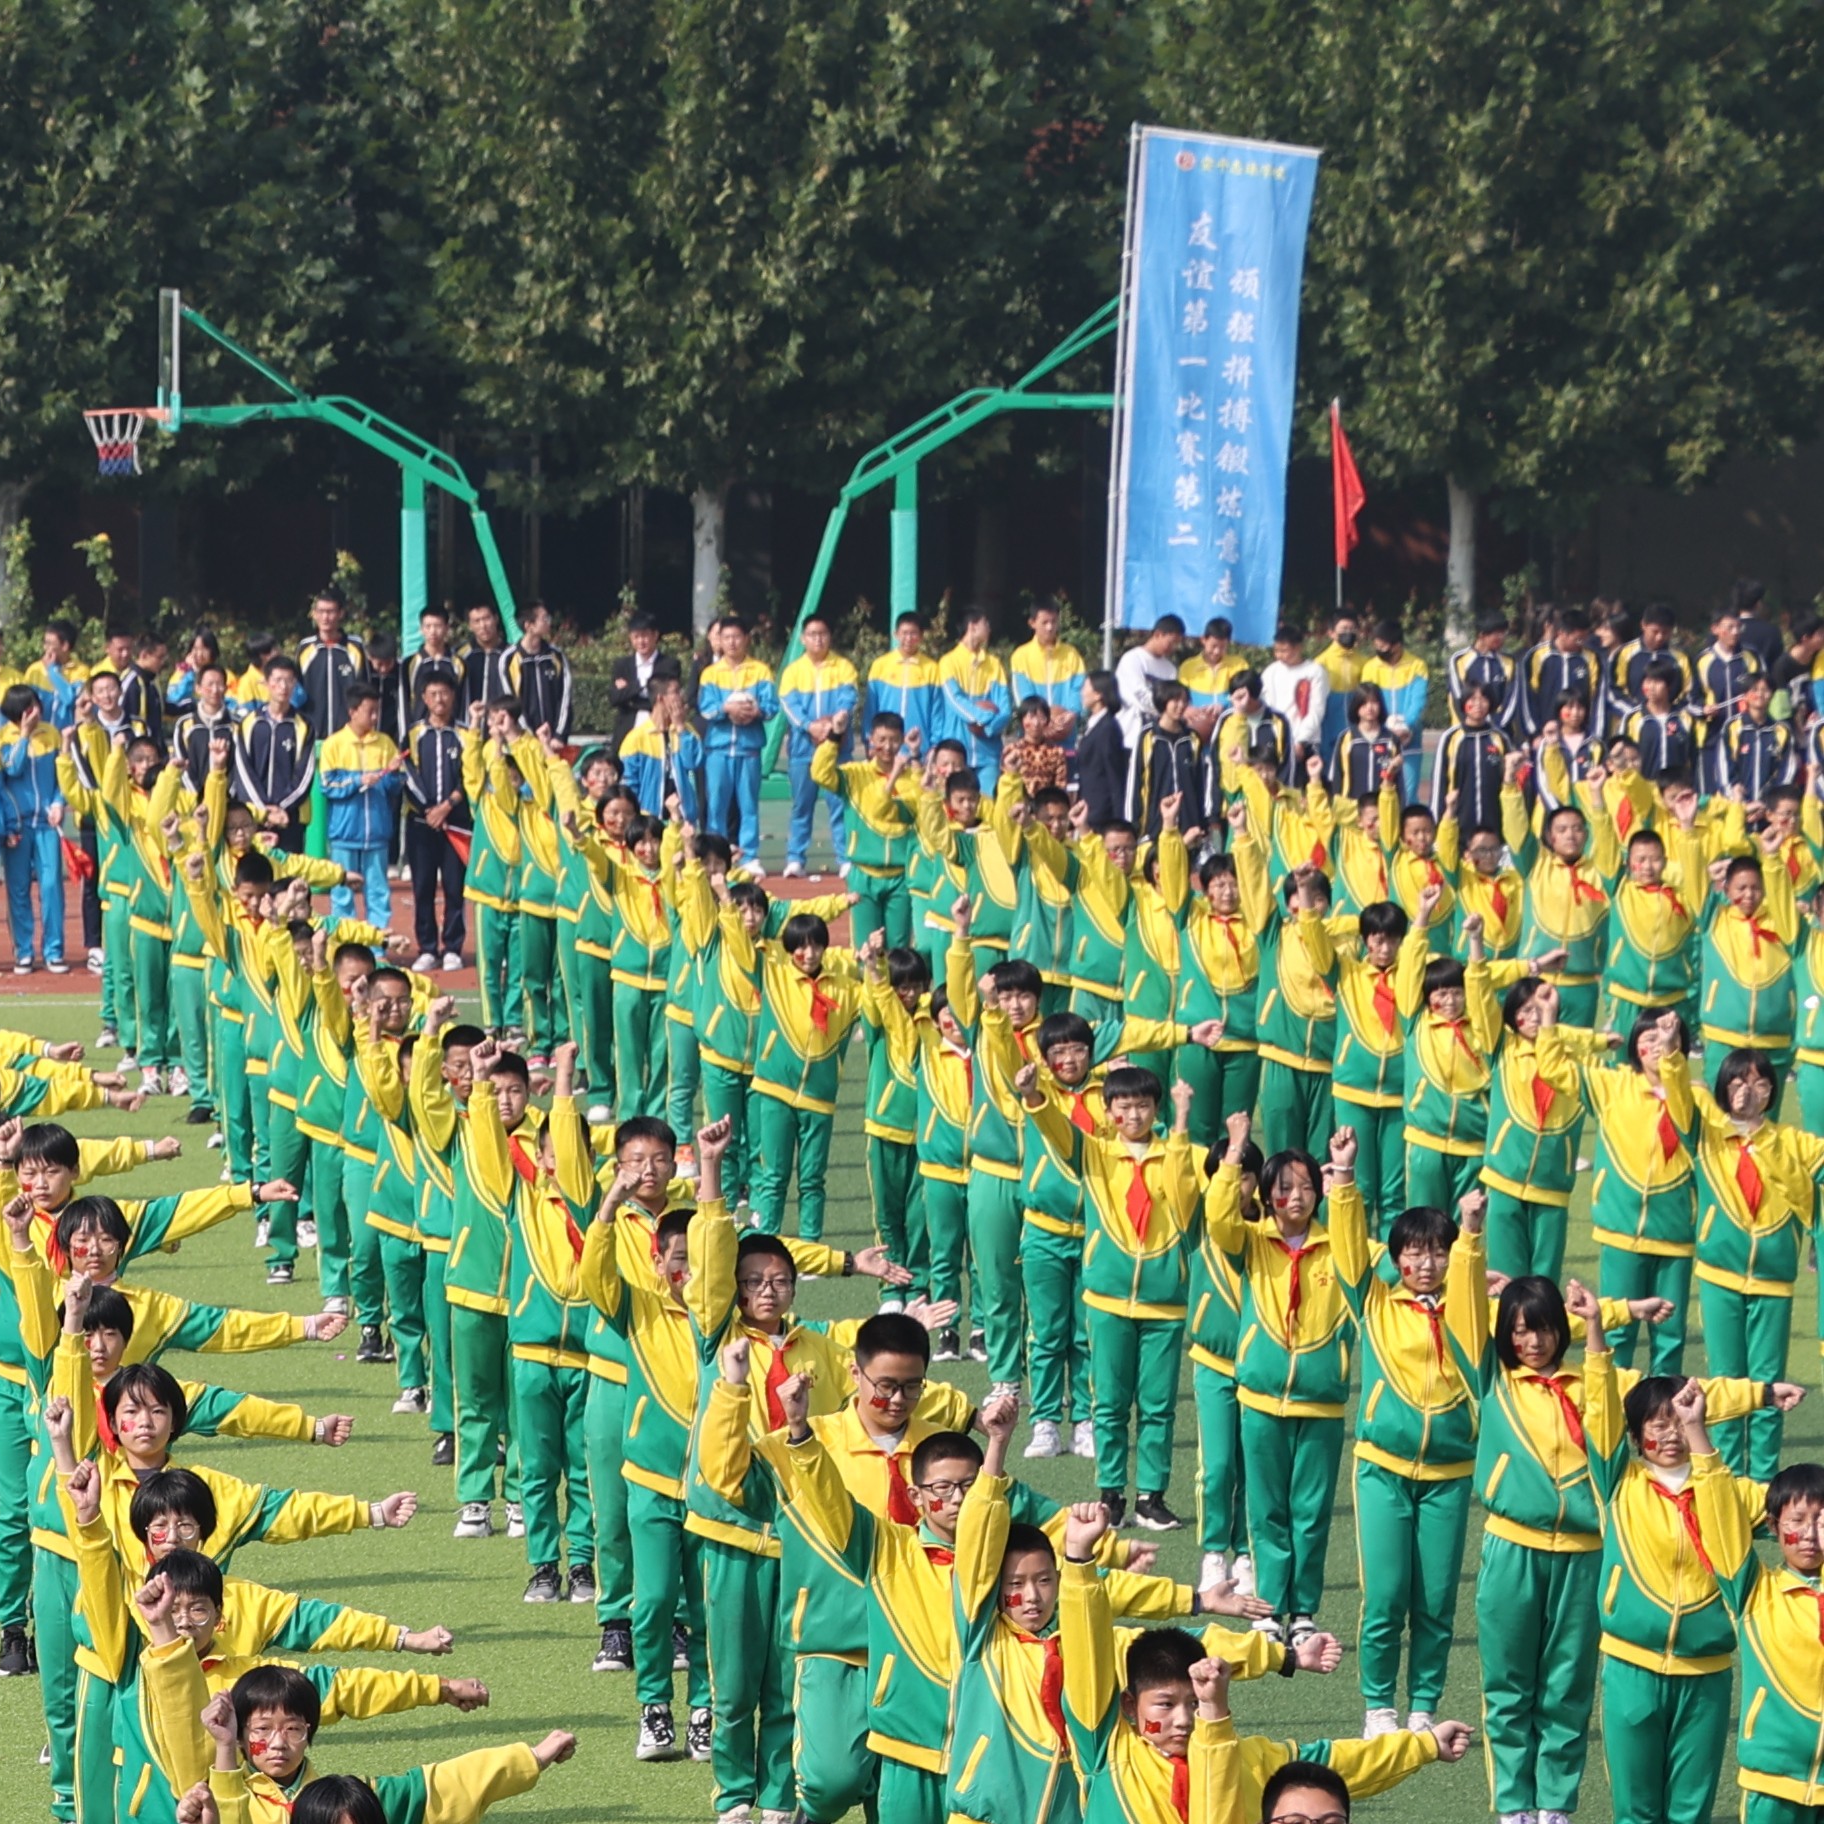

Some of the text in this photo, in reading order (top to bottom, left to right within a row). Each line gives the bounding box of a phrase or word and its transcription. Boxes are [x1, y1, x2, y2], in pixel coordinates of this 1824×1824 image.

[1168, 210, 1218, 547] 友谊第一比赛第二
[1211, 265, 1261, 608] 顽强拼搏锻炼意志
